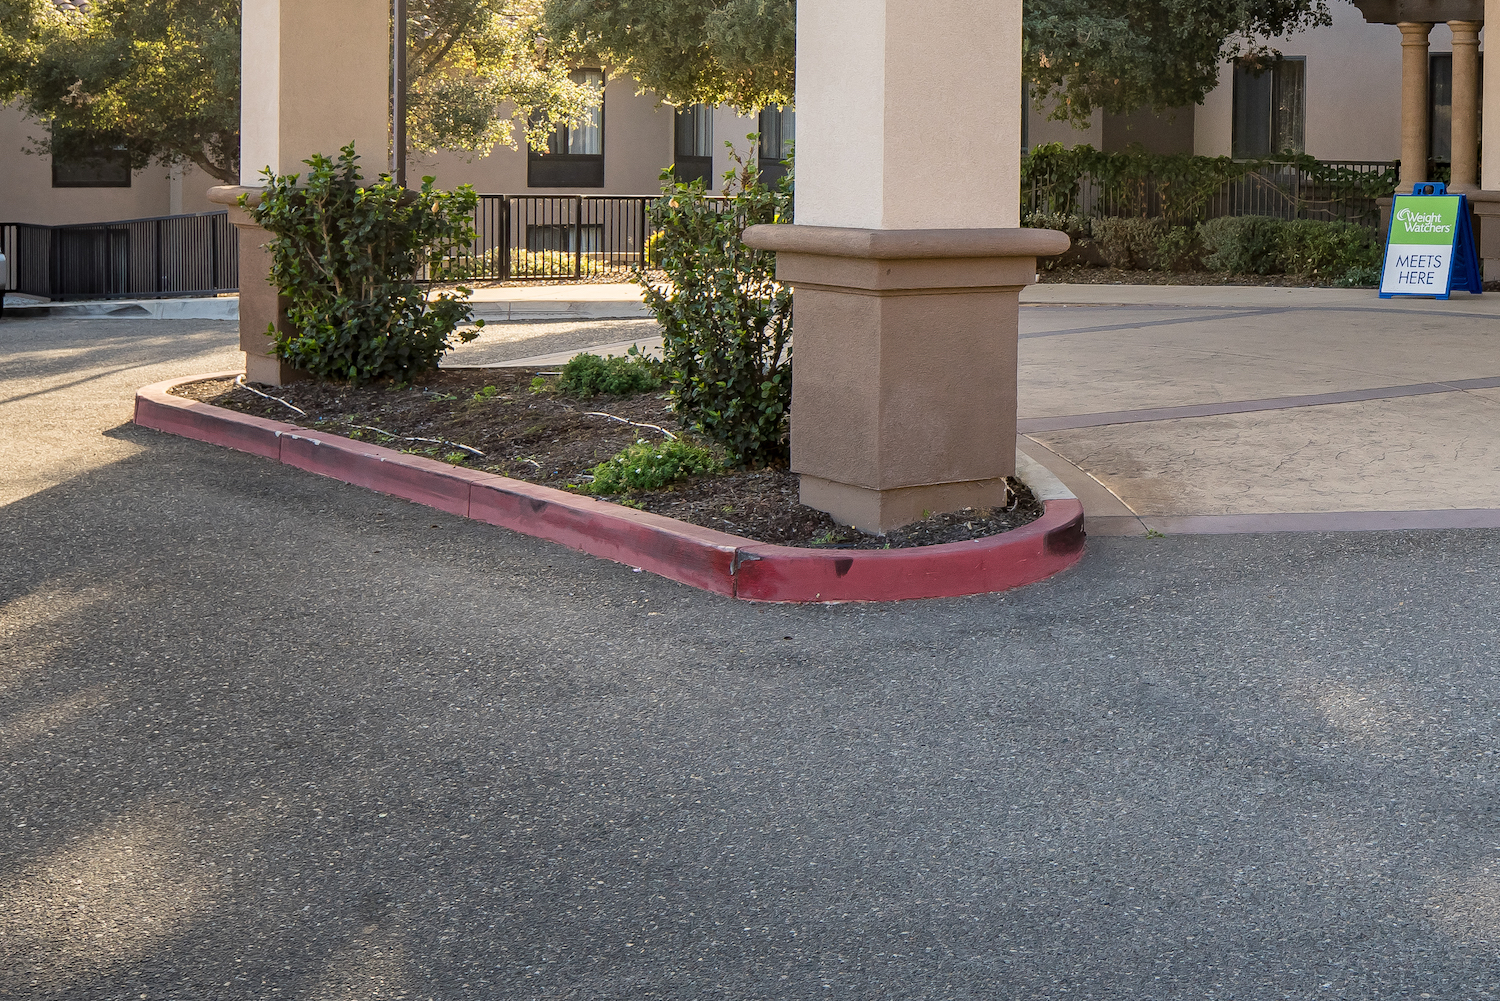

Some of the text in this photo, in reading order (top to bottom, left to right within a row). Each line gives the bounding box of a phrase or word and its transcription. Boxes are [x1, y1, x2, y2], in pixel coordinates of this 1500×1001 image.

[1406, 212, 1442, 224] Weight
[1404, 222, 1450, 233] Watchers
[1395, 255, 1442, 268] MEETS
[1398, 271, 1435, 284] HERE
